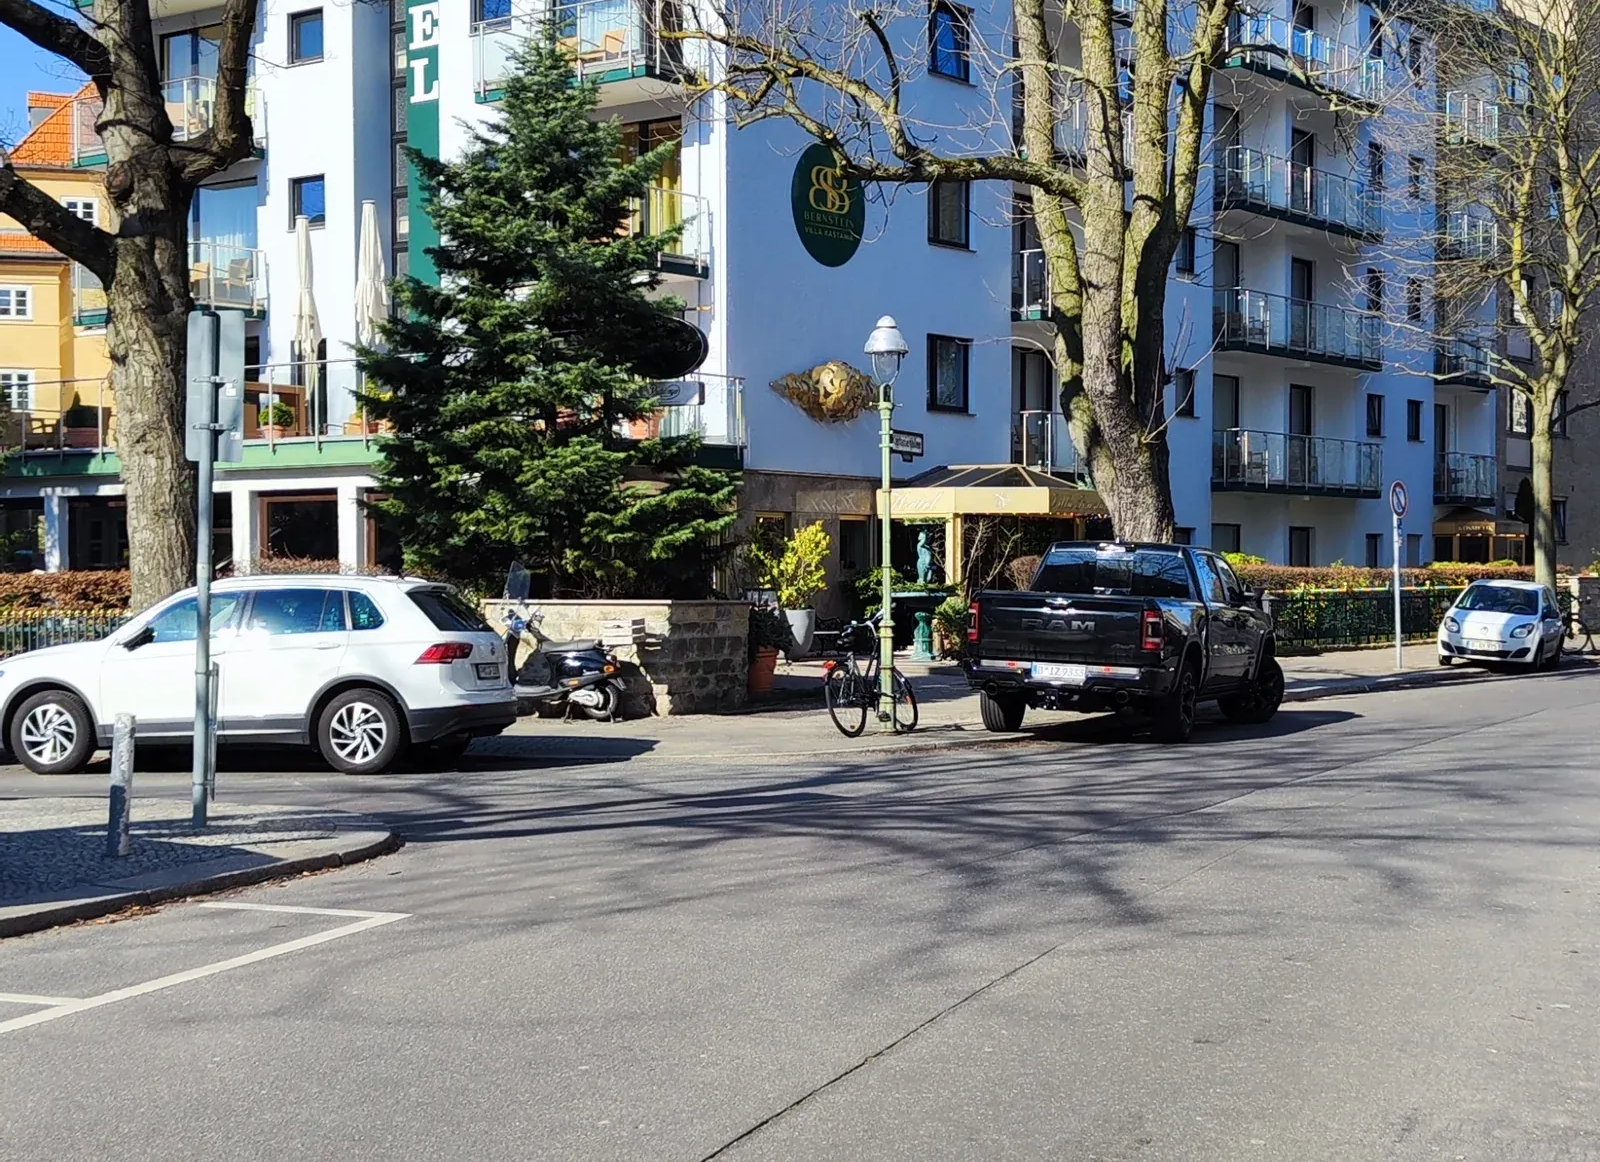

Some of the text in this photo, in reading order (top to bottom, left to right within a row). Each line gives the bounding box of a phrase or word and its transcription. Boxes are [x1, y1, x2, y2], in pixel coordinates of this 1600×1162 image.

[804, 211, 854, 228] BERNSTEIN
[804, 226, 822, 235] VILLA
[1021, 618, 1096, 631] RAM
